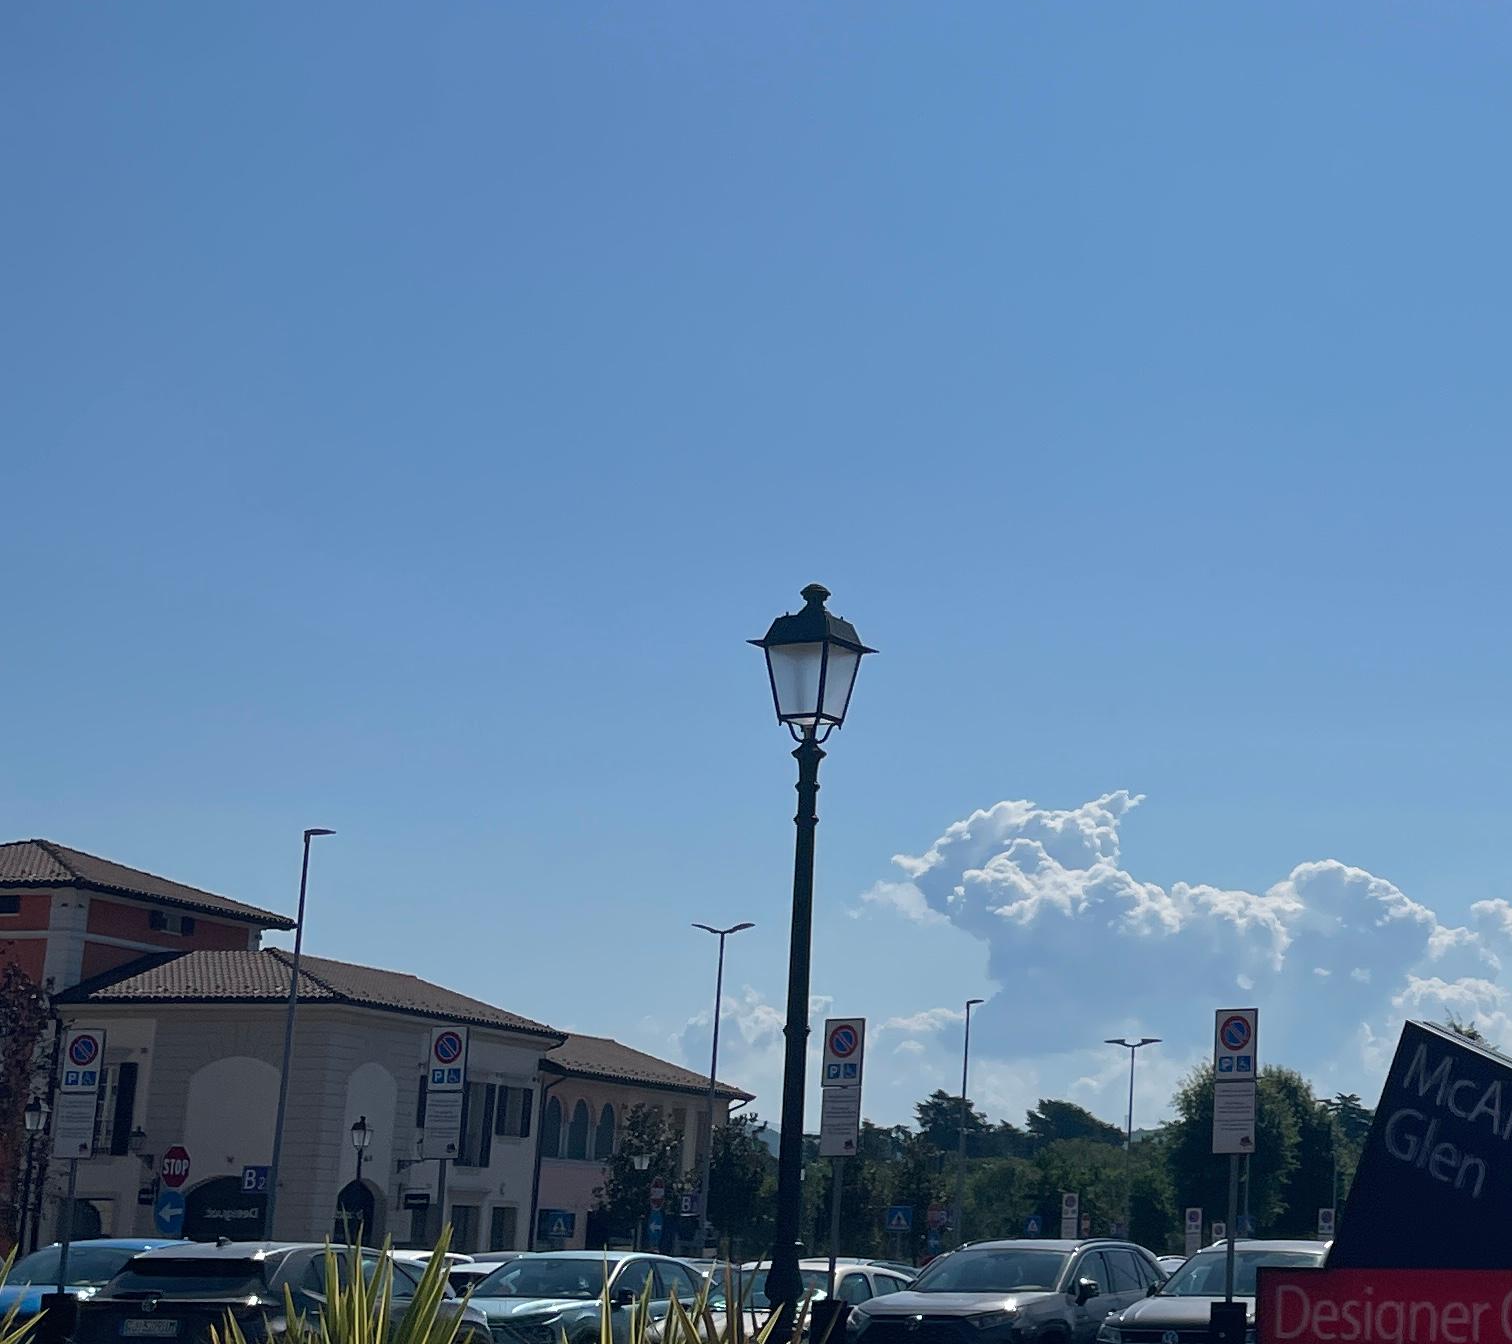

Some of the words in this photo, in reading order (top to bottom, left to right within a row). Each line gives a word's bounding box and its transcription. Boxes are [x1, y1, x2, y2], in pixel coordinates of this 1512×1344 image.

[434, 1070, 442, 1083] P
[1384, 1108, 1486, 1198] Glen
[163, 1158, 189, 1176] STOP
